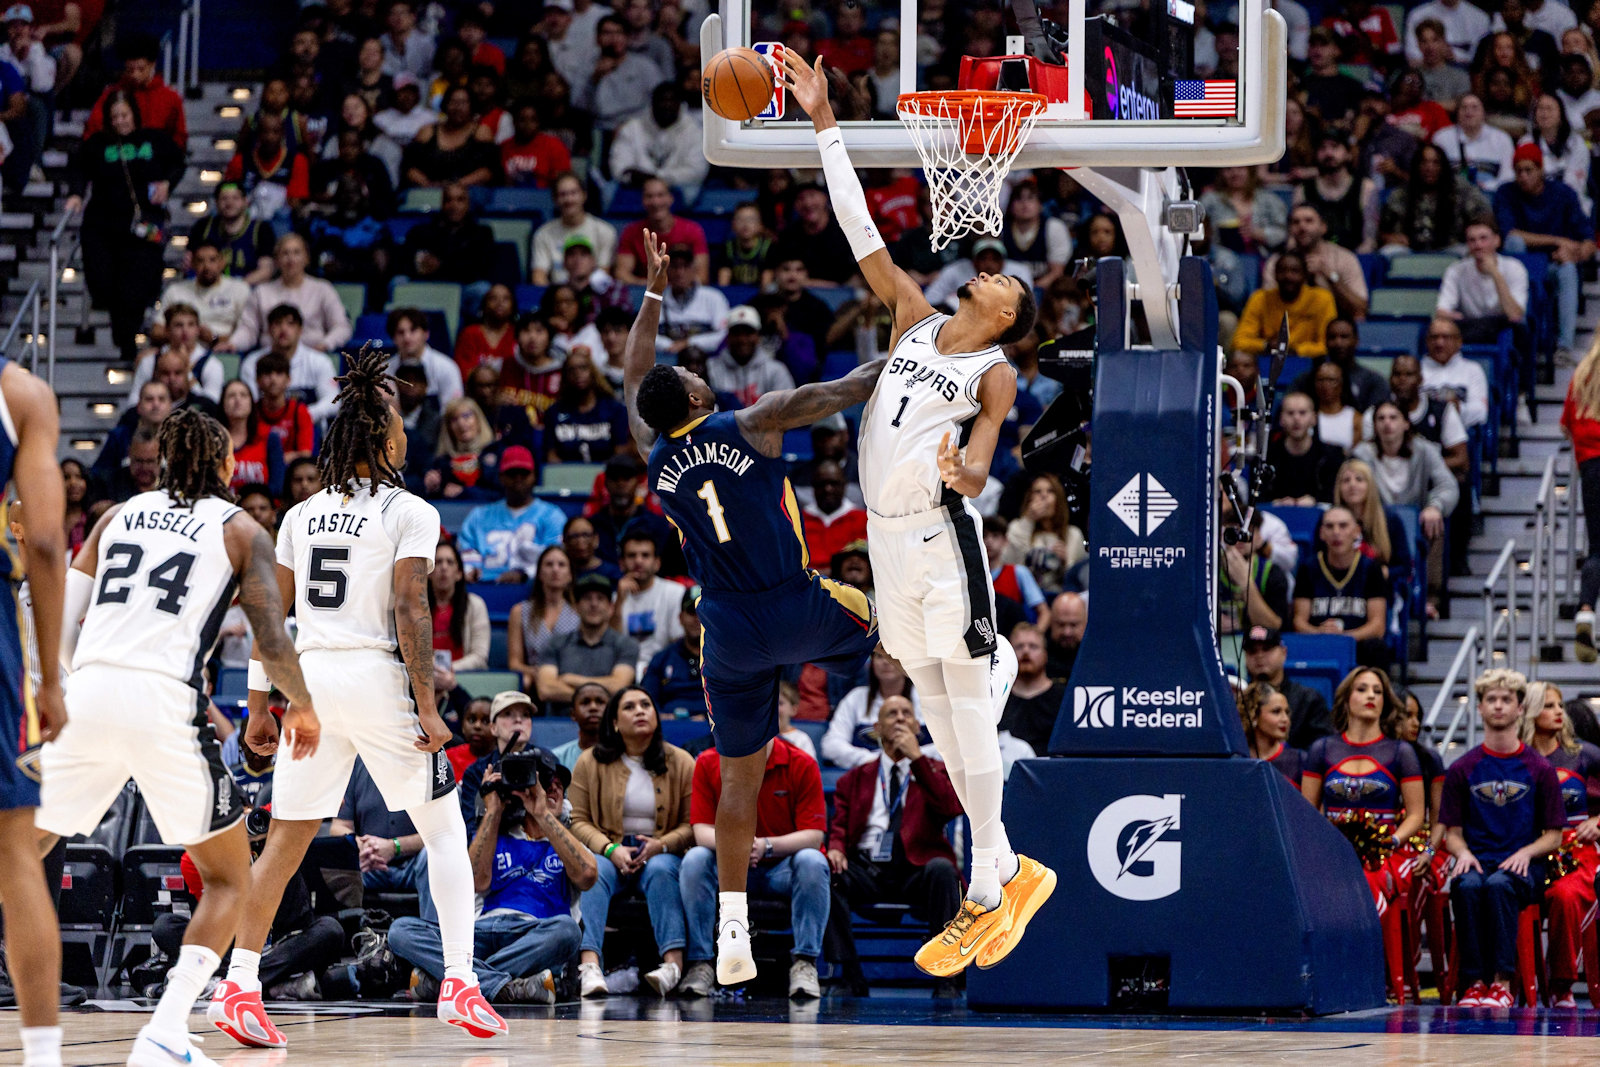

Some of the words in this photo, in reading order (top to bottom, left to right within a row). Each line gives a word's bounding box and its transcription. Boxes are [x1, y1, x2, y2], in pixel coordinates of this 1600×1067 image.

[889, 357, 960, 403] SPURS
[891, 395, 911, 429] 1
[656, 442, 755, 494] WILLIAMSON
[124, 511, 206, 542] VASSELL
[307, 513, 369, 538] CASTLE
[697, 479, 732, 544] 1
[1099, 546, 1186, 558] AMERICAN
[1206, 393, 1225, 677] NEWAGEPRODUCTS.COM
[95, 540, 199, 618] 24
[305, 545, 352, 611] 5
[1110, 557, 1175, 569] SAFETY
[1122, 685, 1205, 706] Keesler
[1122, 707, 1203, 728] Federal
[1086, 793, 1182, 902] G
